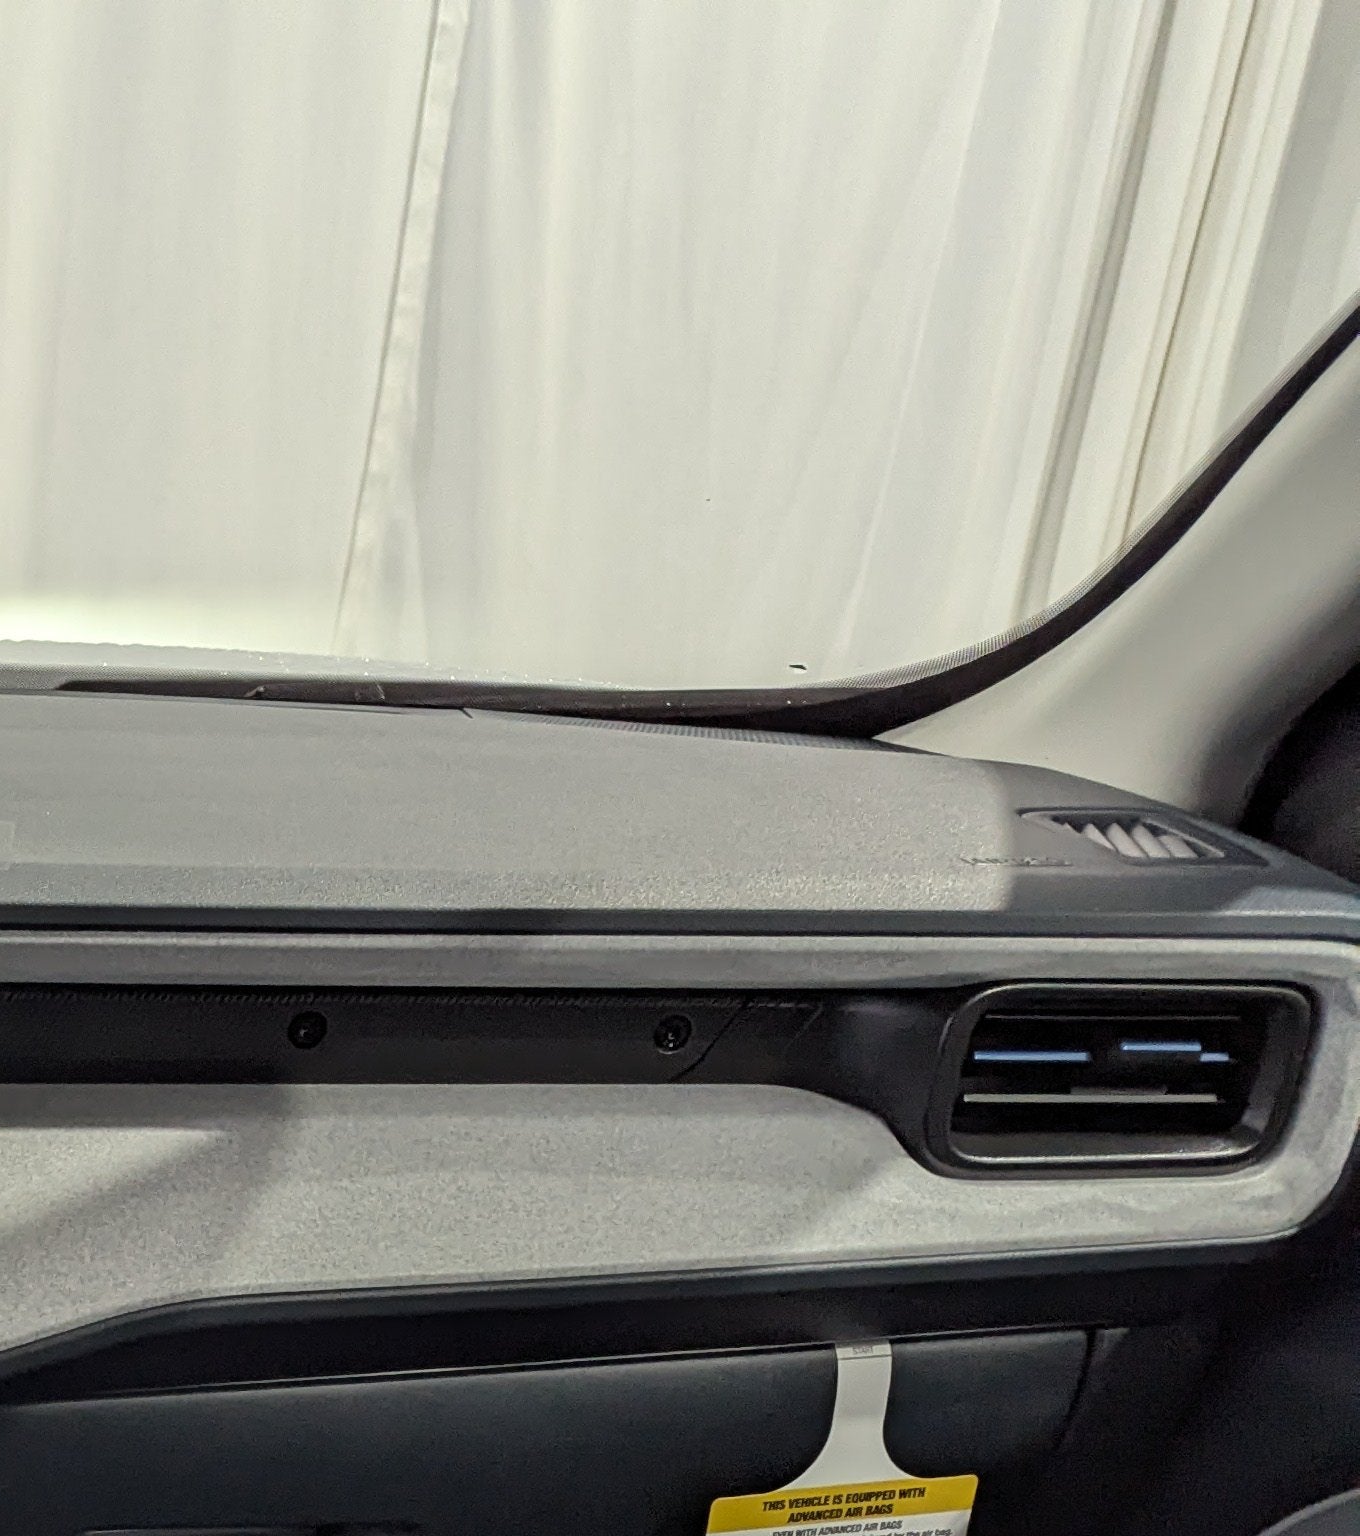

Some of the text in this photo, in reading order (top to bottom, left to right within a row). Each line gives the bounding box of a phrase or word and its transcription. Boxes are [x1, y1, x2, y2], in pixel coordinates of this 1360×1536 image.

[762, 1487, 926, 1512] THIS VEHICLE IS EQUIPPED WITH
[787, 1503, 894, 1523] ADVANCED AIR BAGS
[818, 1524, 862, 1535] ADVANCED
[863, 1522, 878, 1532] AIR
[880, 1520, 903, 1530] BAGS
